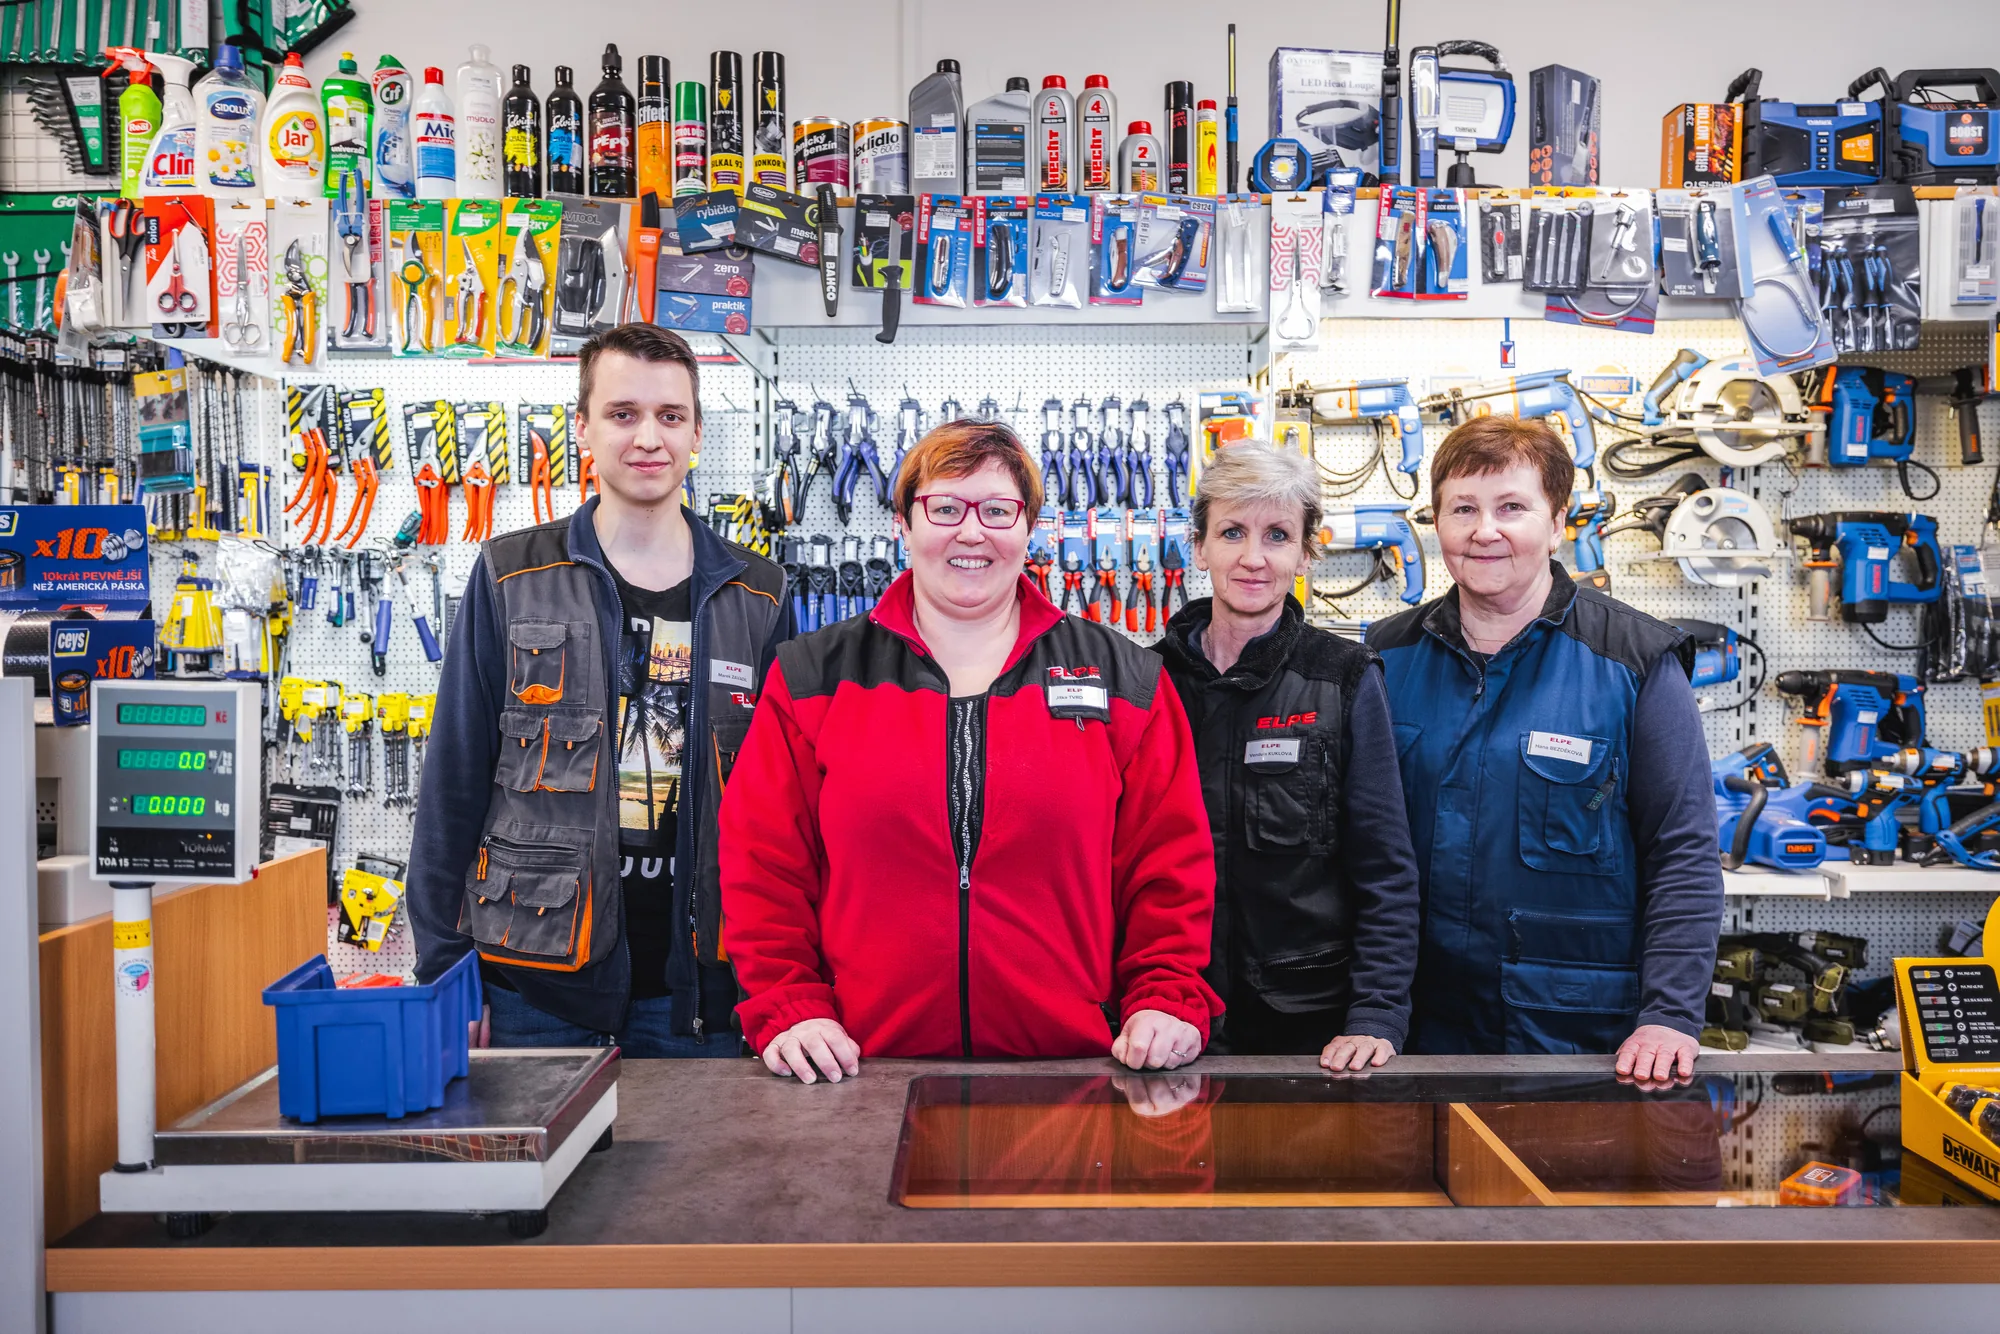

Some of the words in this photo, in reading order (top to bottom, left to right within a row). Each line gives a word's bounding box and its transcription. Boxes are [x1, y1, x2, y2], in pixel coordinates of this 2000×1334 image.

[1301, 78, 1321, 86] LED
[1324, 80, 1346, 88] Head
[1349, 81, 1375, 90] Loupe
[382, 84, 402, 102] Cif
[214, 103, 251, 115] SIDOLUX
[1091, 101, 1100, 113] 4
[638, 106, 670, 126] Effect
[1686, 106, 1694, 126] 230V
[1696, 106, 1710, 141] MOTOR
[284, 130, 308, 147] Jar
[1950, 126, 1983, 138] BOOST
[803, 142, 838, 158] benzín
[854, 132, 899, 159] edidlo
[1138, 146, 1148, 158] 2
[1695, 144, 1708, 172] GRILL
[52, 196, 78, 208] Go
[696, 204, 736, 219] rybička
[920, 196, 930, 240] FESTA
[529, 220, 549, 230] ŽKY
[790, 227, 818, 240] maste
[714, 264, 740, 274] zero
[826, 262, 836, 301] BAHCO
[712, 300, 746, 311] praktik
[328, 414, 336, 425] NA
[32, 528, 109, 560] x10
[42, 571, 79, 580] 10krát
[83, 569, 142, 580] PEVNĚJŠÍ
[34, 581, 54, 590] NEŽ
[56, 581, 108, 590] AMERICKÁ
[111, 581, 144, 590] PÁSKA
[58, 632, 85, 652] ceys
[95, 646, 136, 678] x10
[1050, 666, 1100, 678] ELPE
[216, 711, 228, 723] Kč
[1256, 712, 1318, 729] ELPE
[1550, 737, 1572, 746] ELPE
[178, 752, 206, 770] 0.0
[149, 796, 206, 814] 0.000
[215, 800, 230, 816] kg
[99, 857, 117, 867] TOA
[119, 858, 130, 868] 15
